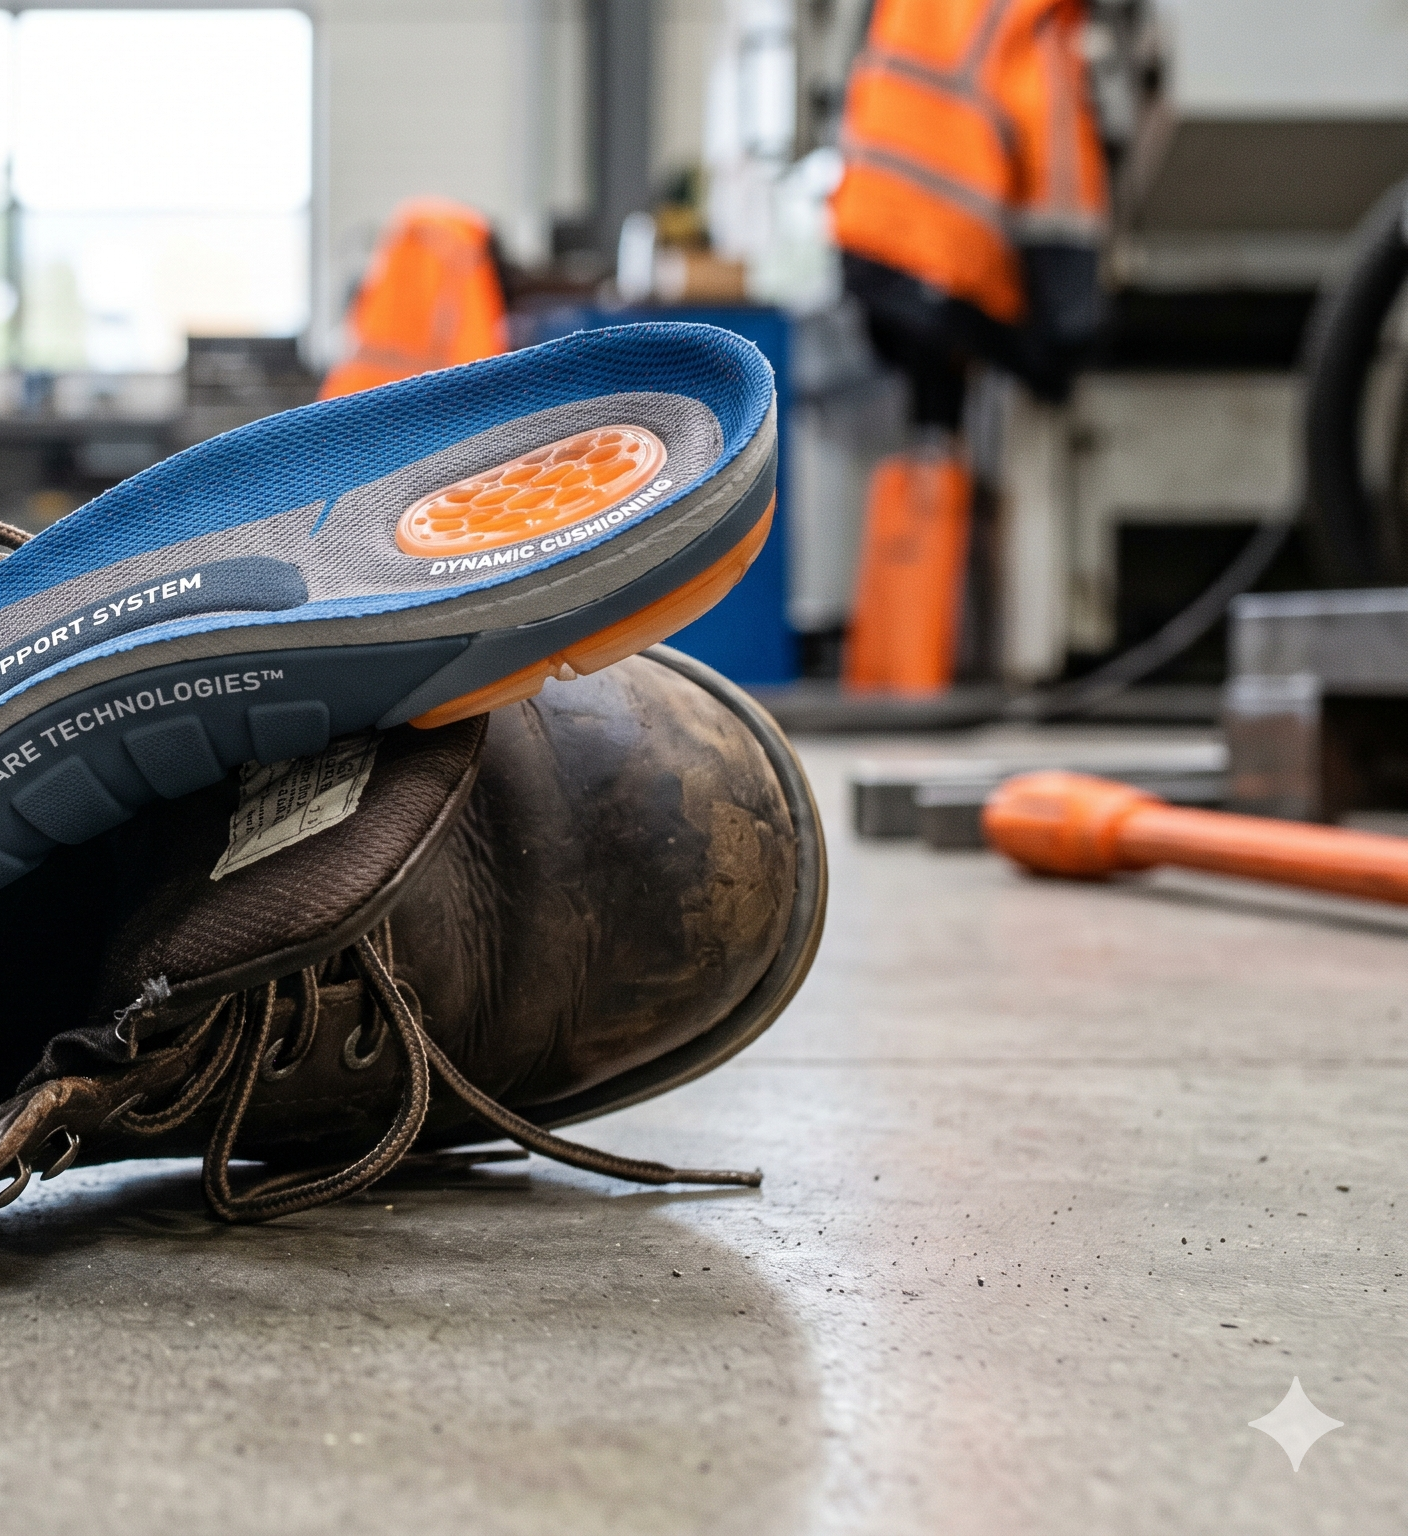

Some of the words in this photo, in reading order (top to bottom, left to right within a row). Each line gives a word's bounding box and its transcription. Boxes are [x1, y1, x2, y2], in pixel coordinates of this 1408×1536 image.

[429, 545, 535, 576] DYNAMIC
[540, 478, 673, 553] CUSHIONING
[92, 573, 202, 626] SYSTEM
